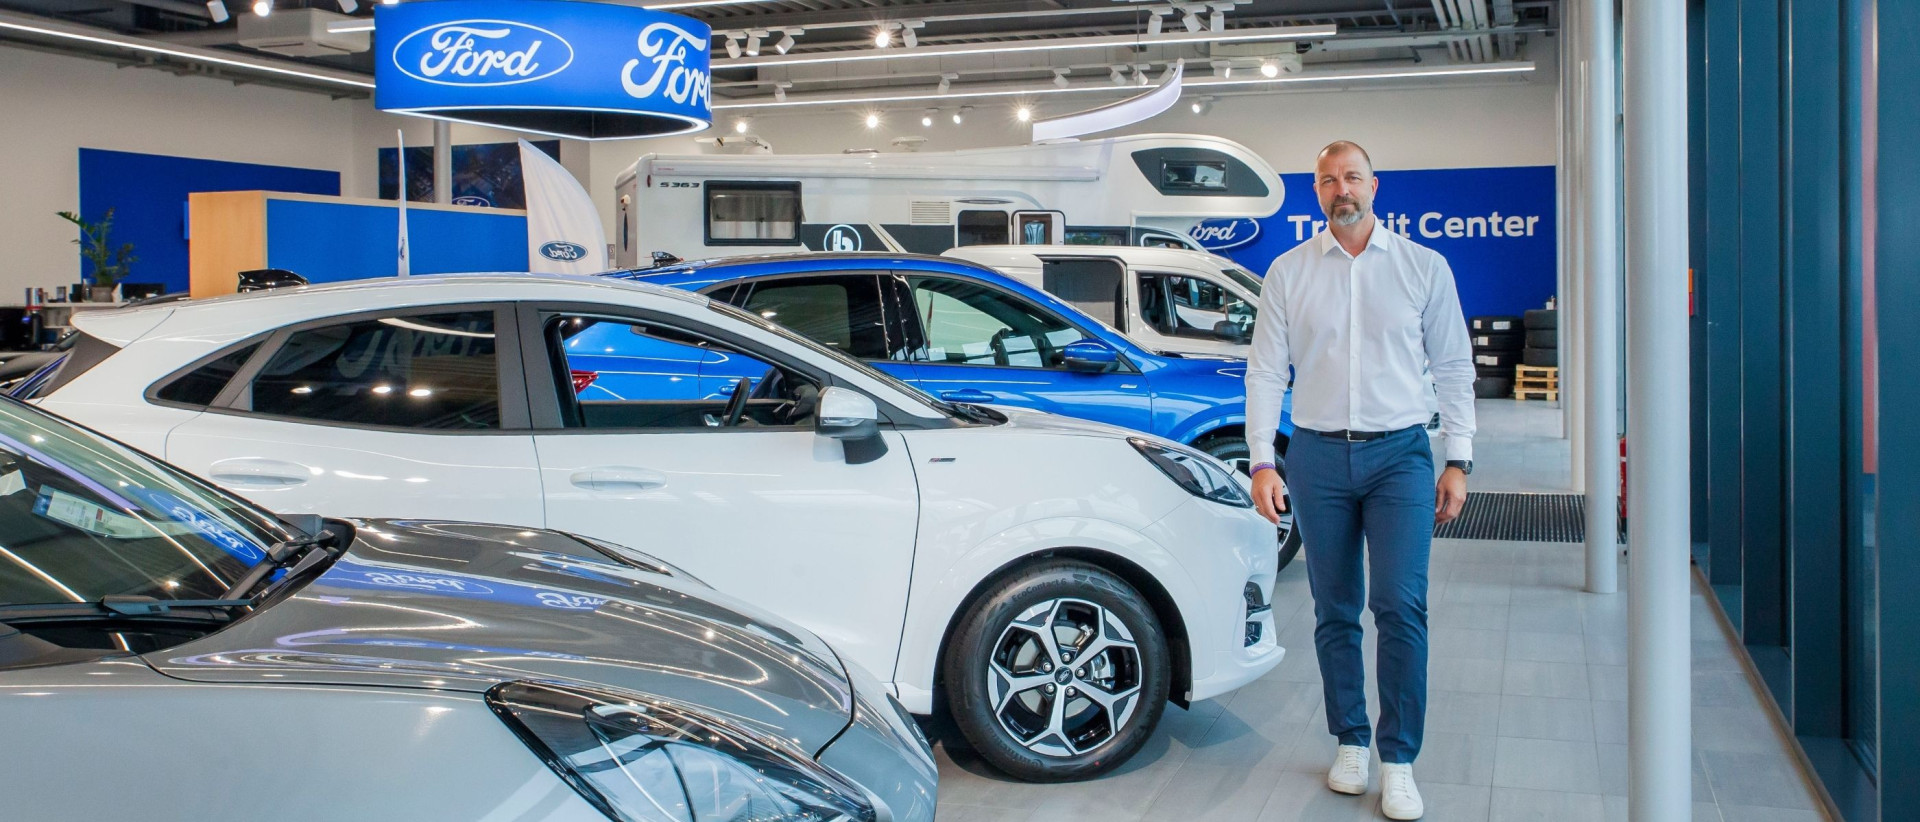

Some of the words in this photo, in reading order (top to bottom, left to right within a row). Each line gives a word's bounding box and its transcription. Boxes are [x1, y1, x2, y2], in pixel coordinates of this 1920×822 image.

[420, 26, 542, 76] Ford
[1191, 220, 1238, 240] ord
[1287, 212, 1411, 241] Trit
[1418, 211, 1540, 239] Center
